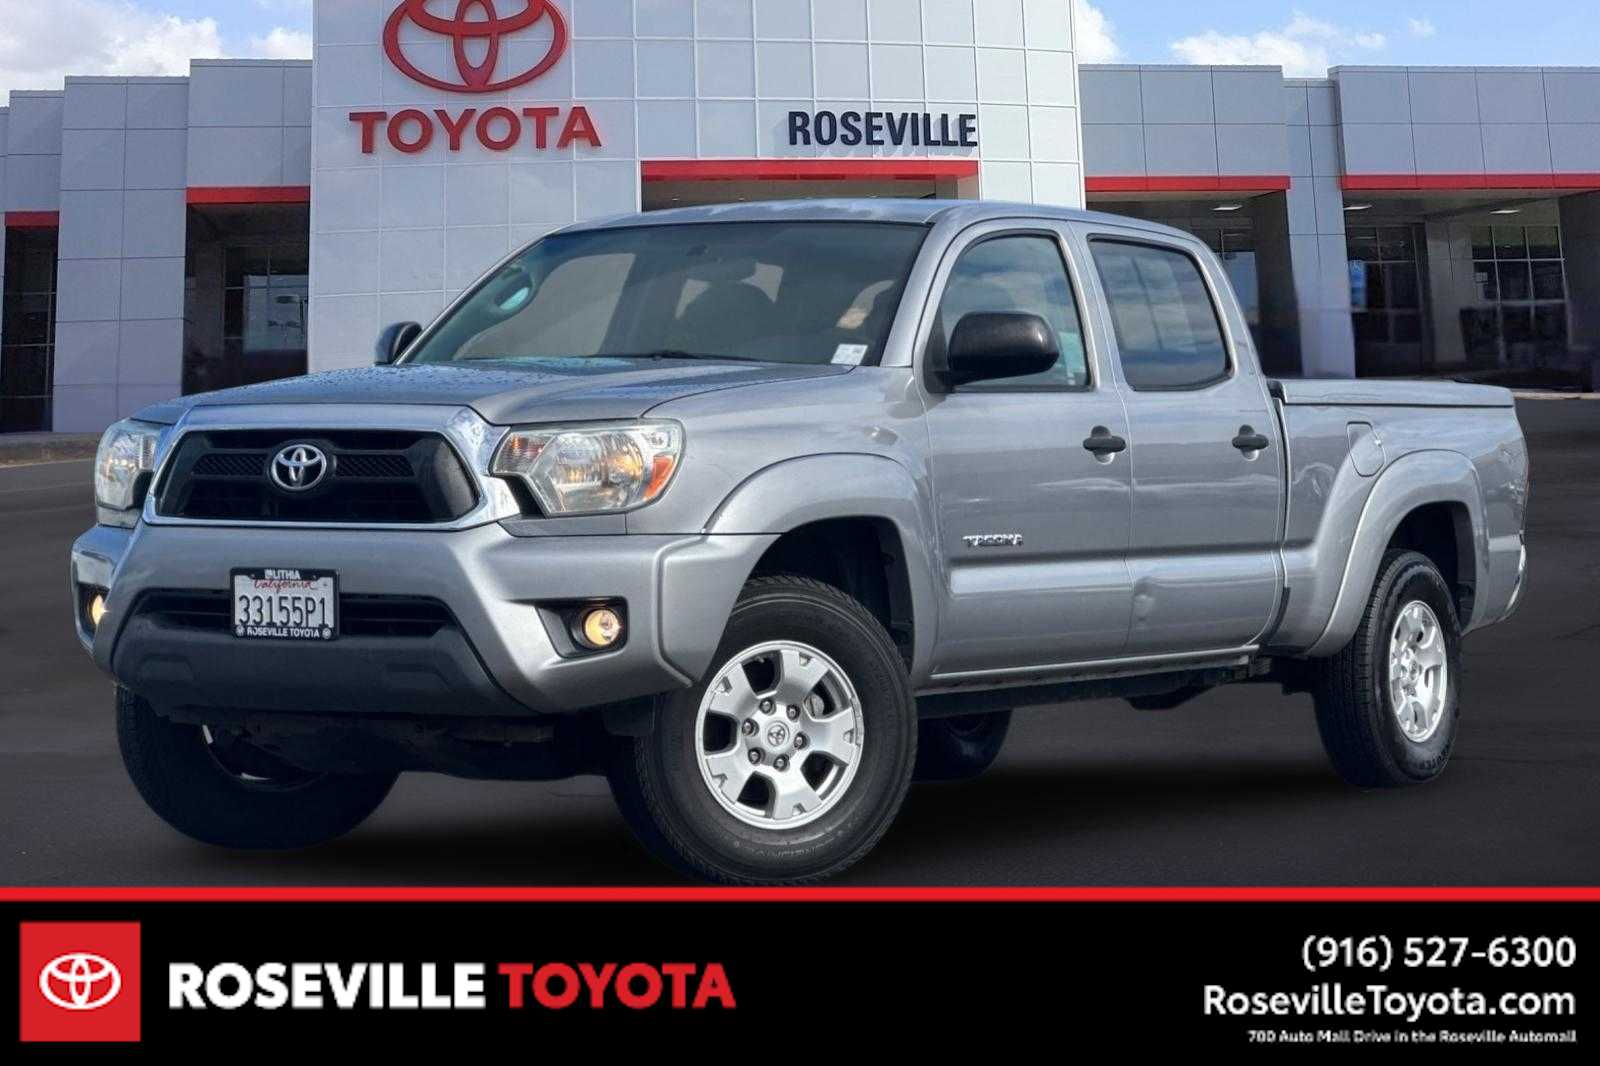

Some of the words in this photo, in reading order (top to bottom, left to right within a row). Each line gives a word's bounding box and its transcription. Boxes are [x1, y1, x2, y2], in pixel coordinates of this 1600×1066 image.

[349, 106, 602, 154] TOYOTA
[788, 111, 978, 147] ROSEVILLE
[254, 579, 318, 593] California
[238, 595, 327, 627] 33155P1
[247, 627, 288, 637] ROSEVILLE
[289, 628, 320, 638] TOYOTA
